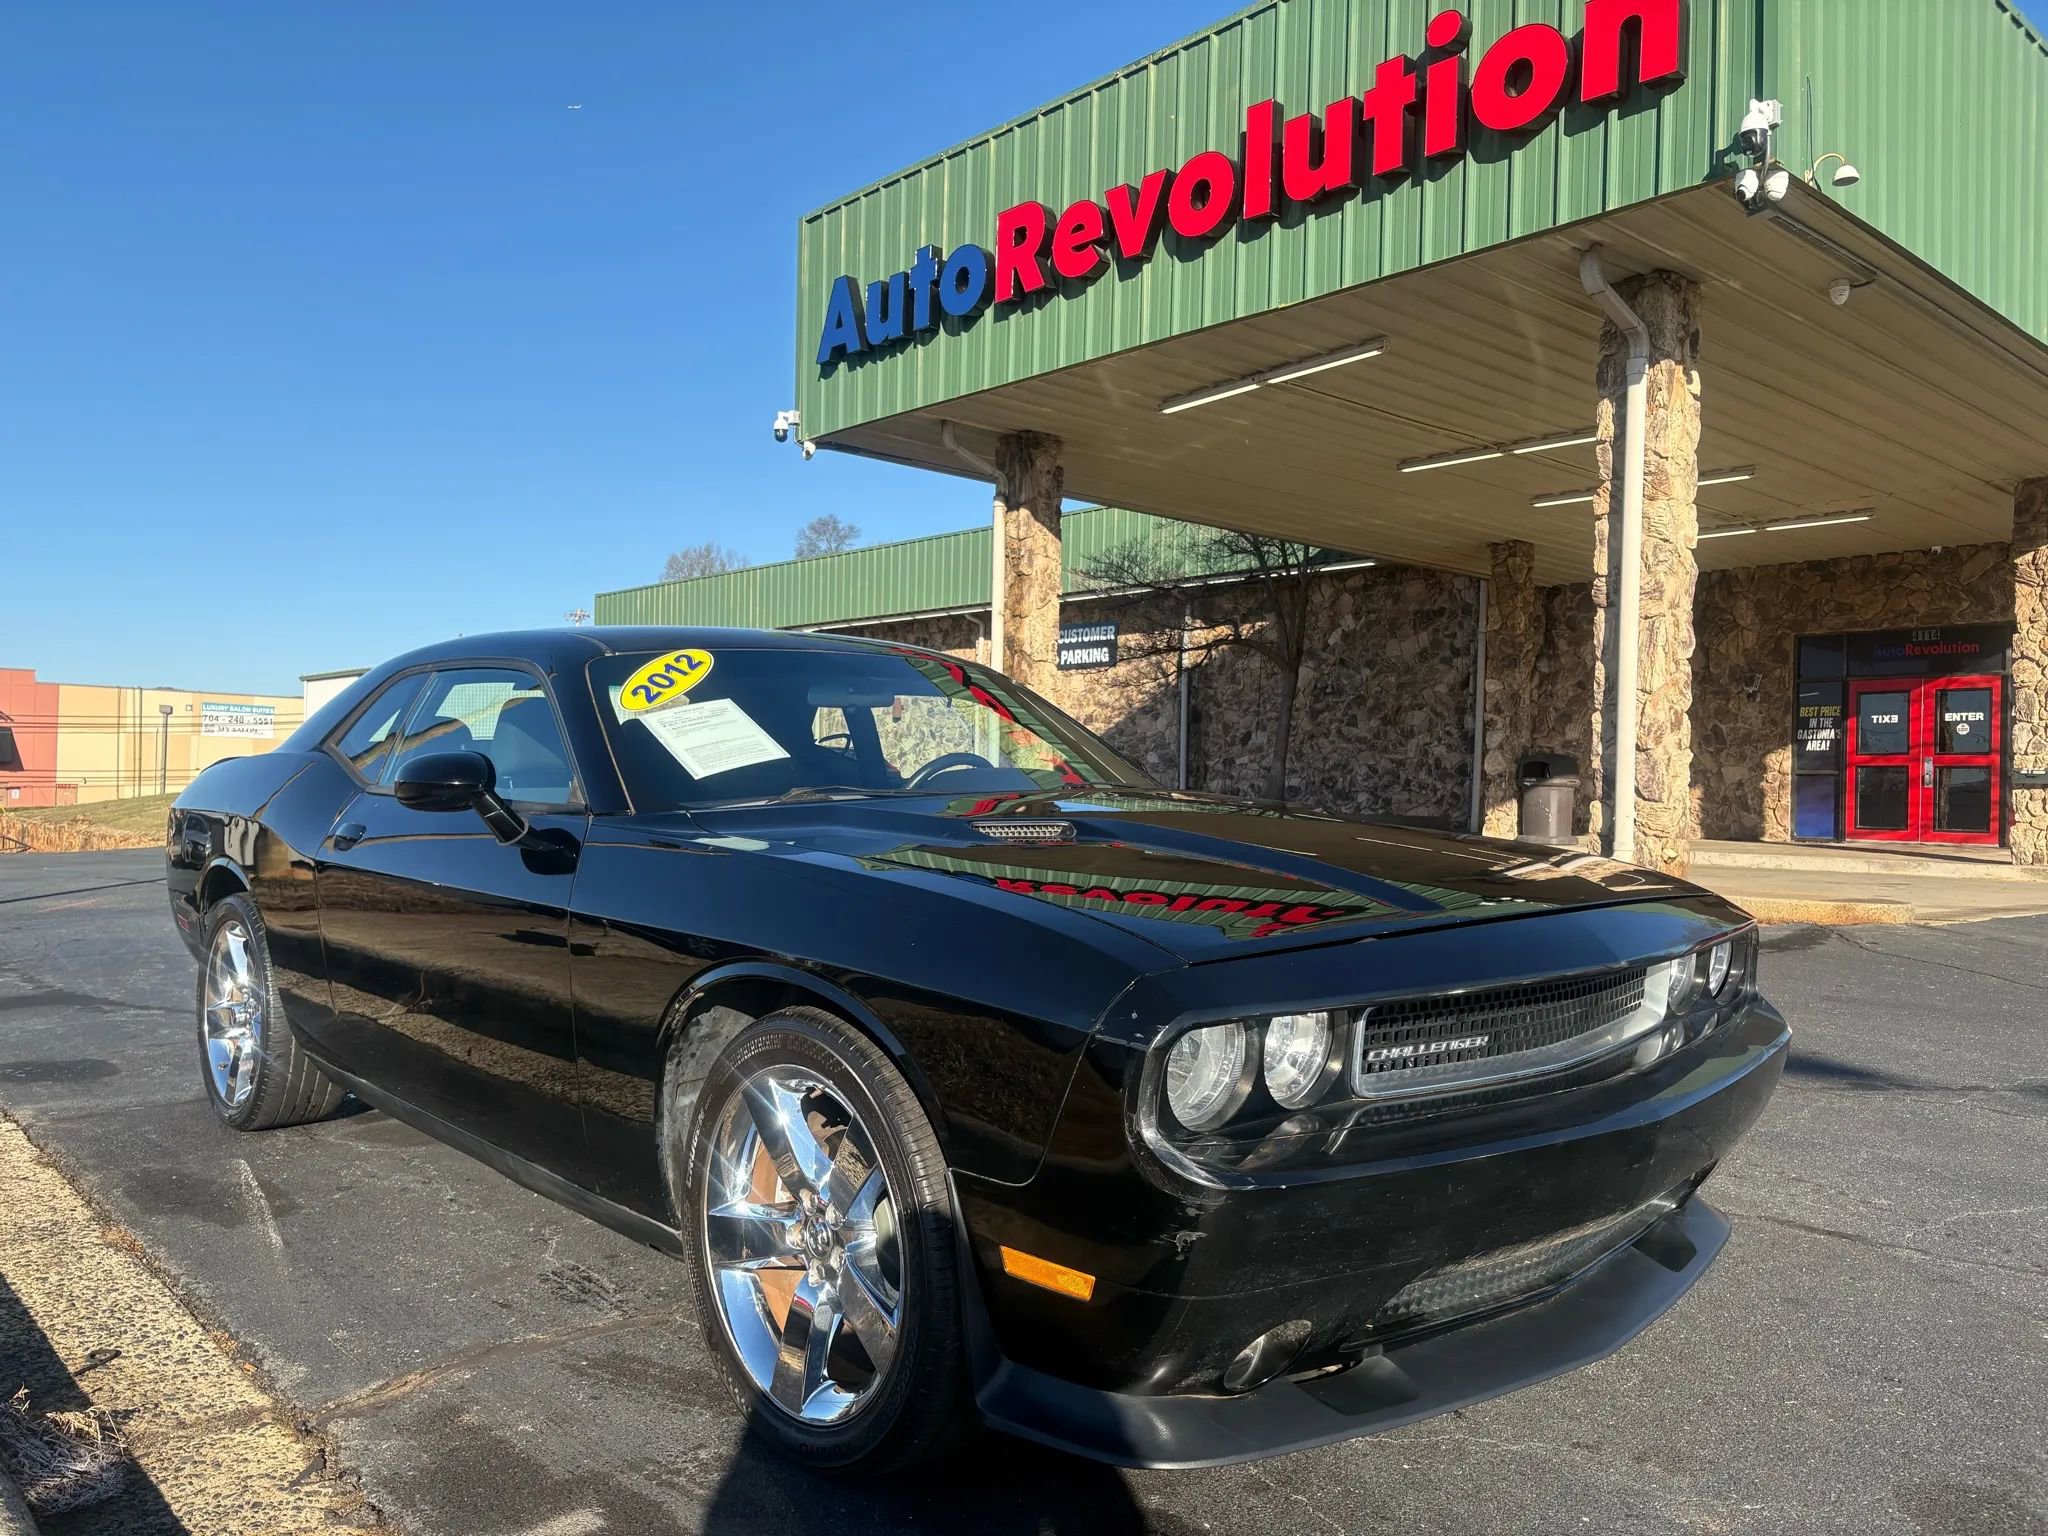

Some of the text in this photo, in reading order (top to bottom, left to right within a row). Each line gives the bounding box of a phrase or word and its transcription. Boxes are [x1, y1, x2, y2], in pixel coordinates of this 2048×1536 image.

[1058, 625, 1116, 644] CUSTOMER
[1060, 647, 1110, 665] PARKING
[631, 654, 704, 704] 2012
[1800, 705, 1841, 717] BEST PRICE
[1944, 712, 1984, 721] ENTER
[1809, 717, 1834, 728] IN THE
[1806, 739, 1830, 751] AREA!
[1368, 1035, 1489, 1061] CHALLENGER
